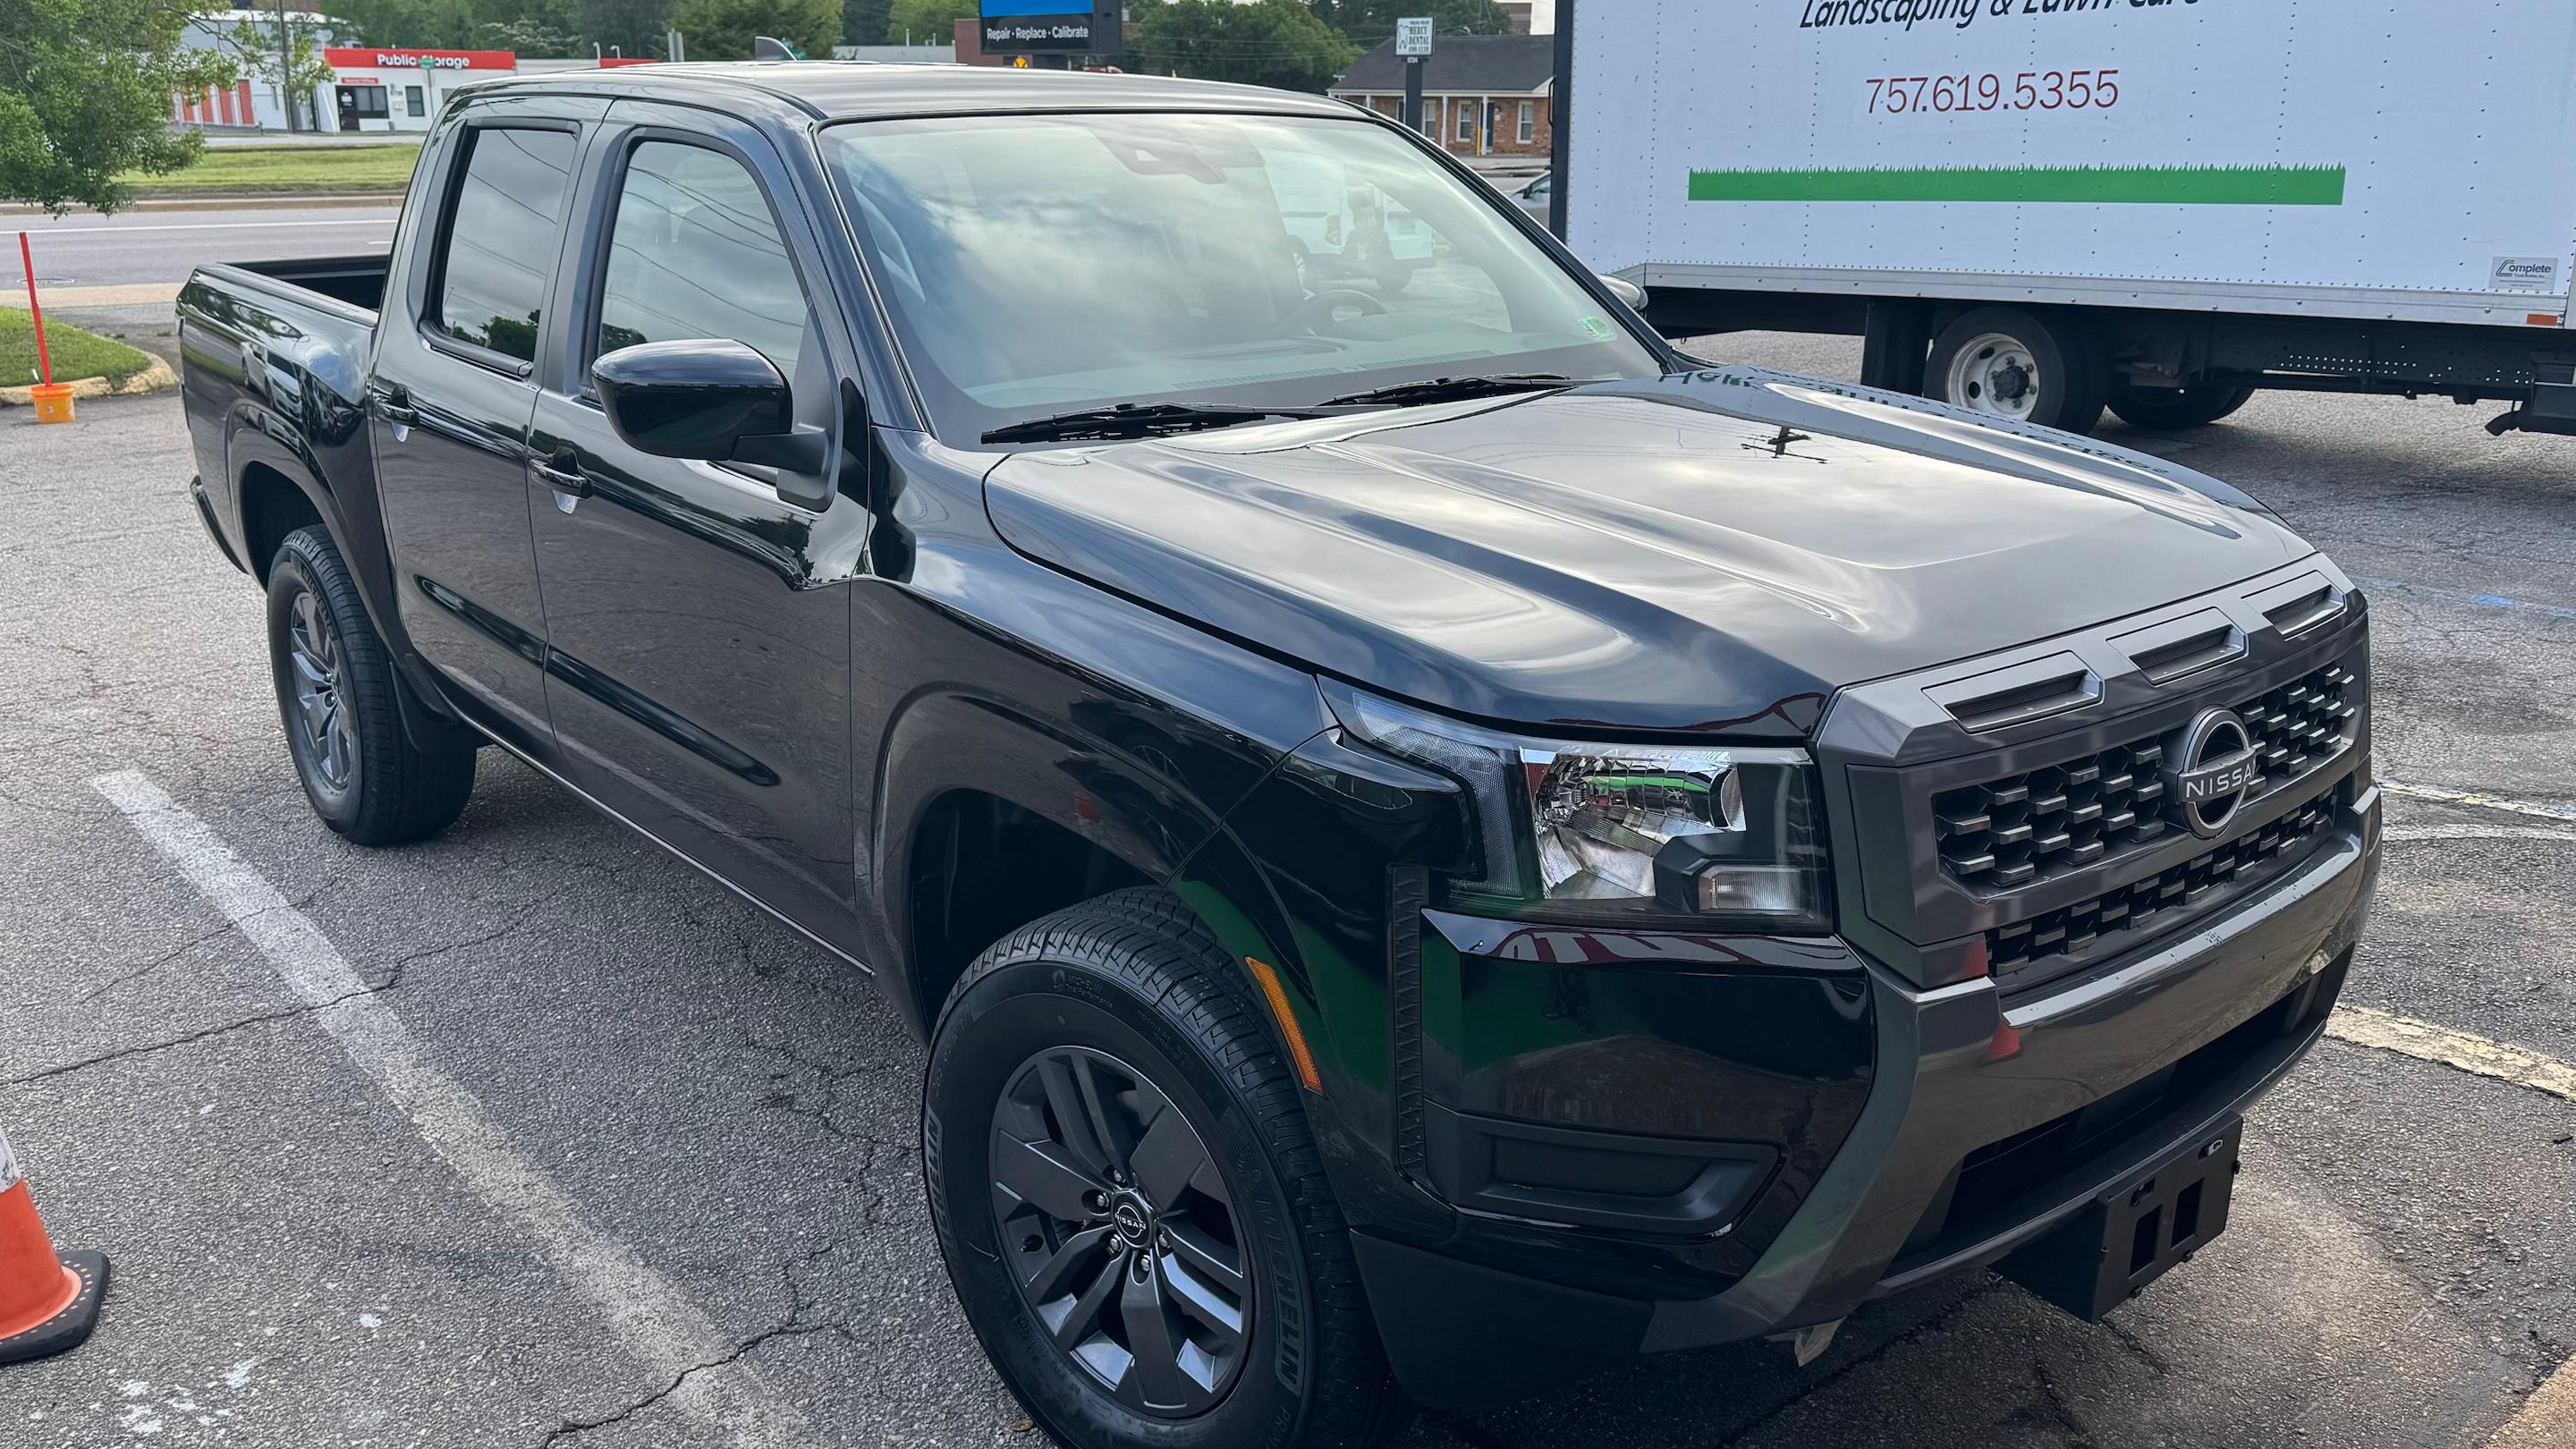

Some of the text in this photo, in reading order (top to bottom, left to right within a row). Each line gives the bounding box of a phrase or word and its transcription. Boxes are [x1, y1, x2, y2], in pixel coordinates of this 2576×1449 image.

[1800, 0, 1979, 31] Landscaping
[987, 26, 1089, 41] Repair Replace Calibrate
[377, 54, 417, 65] Public
[1866, 70, 2119, 114] 757.619.5355
[1114, 1213, 1146, 1230] NISSAN
